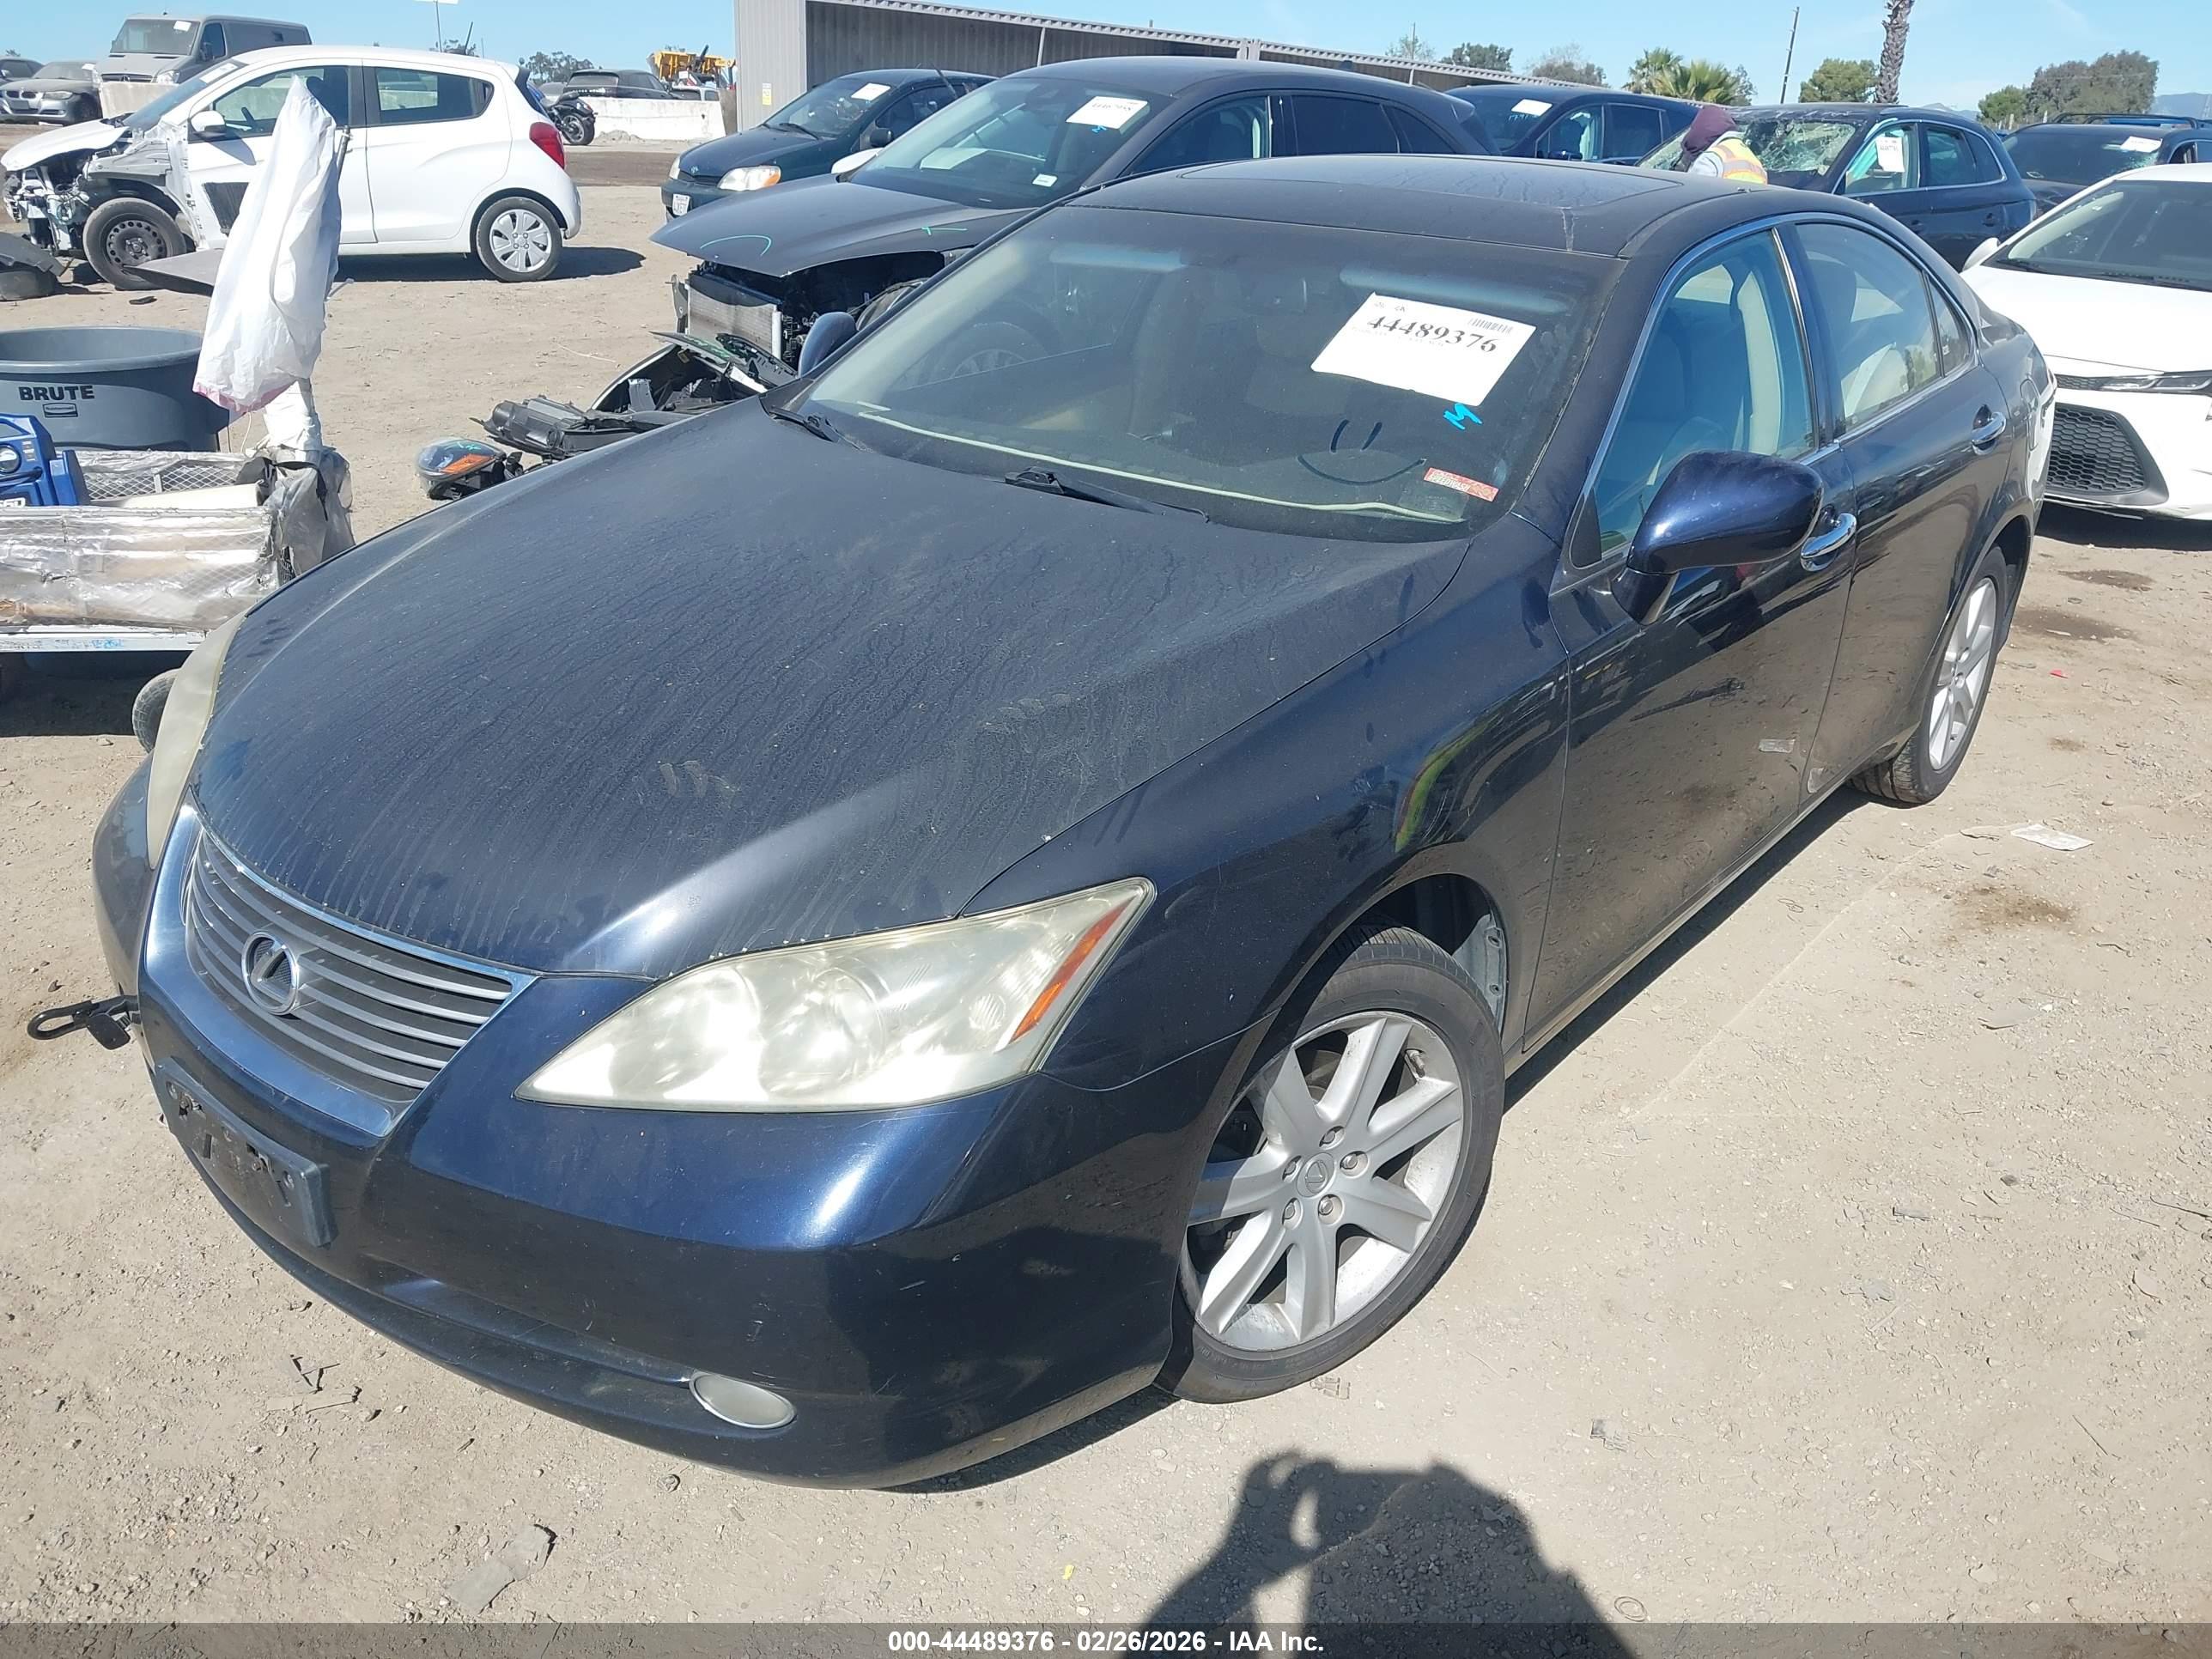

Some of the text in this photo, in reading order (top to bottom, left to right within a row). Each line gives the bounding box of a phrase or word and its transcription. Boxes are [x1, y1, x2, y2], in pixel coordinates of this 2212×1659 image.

[1367, 315, 1499, 353] 44489376
[18, 385, 95, 401] BRUTE
[1443, 402, 1483, 430] M
